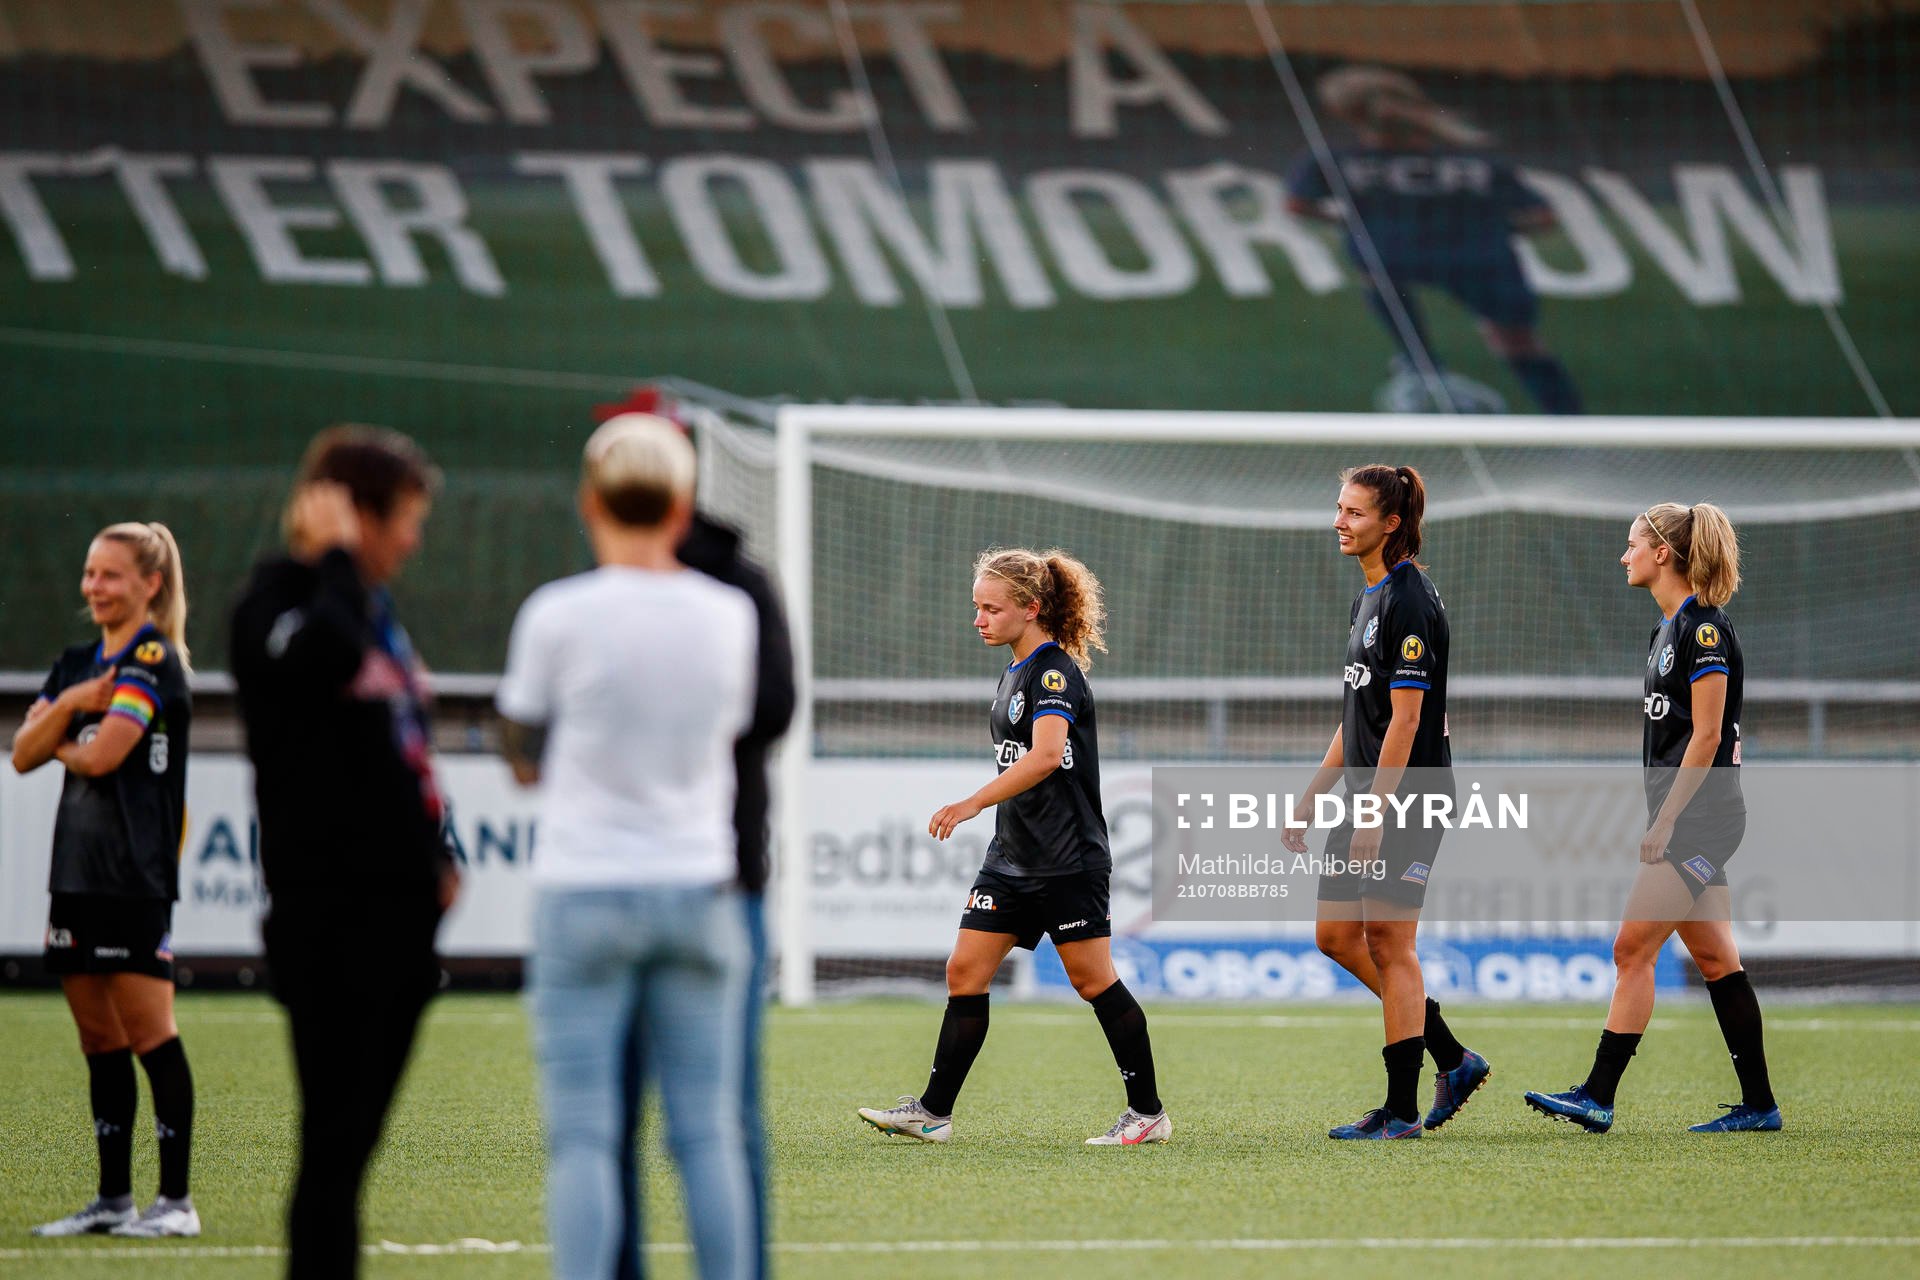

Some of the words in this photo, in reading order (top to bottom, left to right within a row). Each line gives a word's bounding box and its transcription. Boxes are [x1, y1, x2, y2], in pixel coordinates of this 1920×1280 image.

[185, 0, 976, 132] EXPECT
[1066, 0, 1228, 137] A
[513, 153, 1843, 308] TOMOROW
[1059, 920, 1081, 931] CRAFT
[1475, 951, 1618, 1000] OBO
